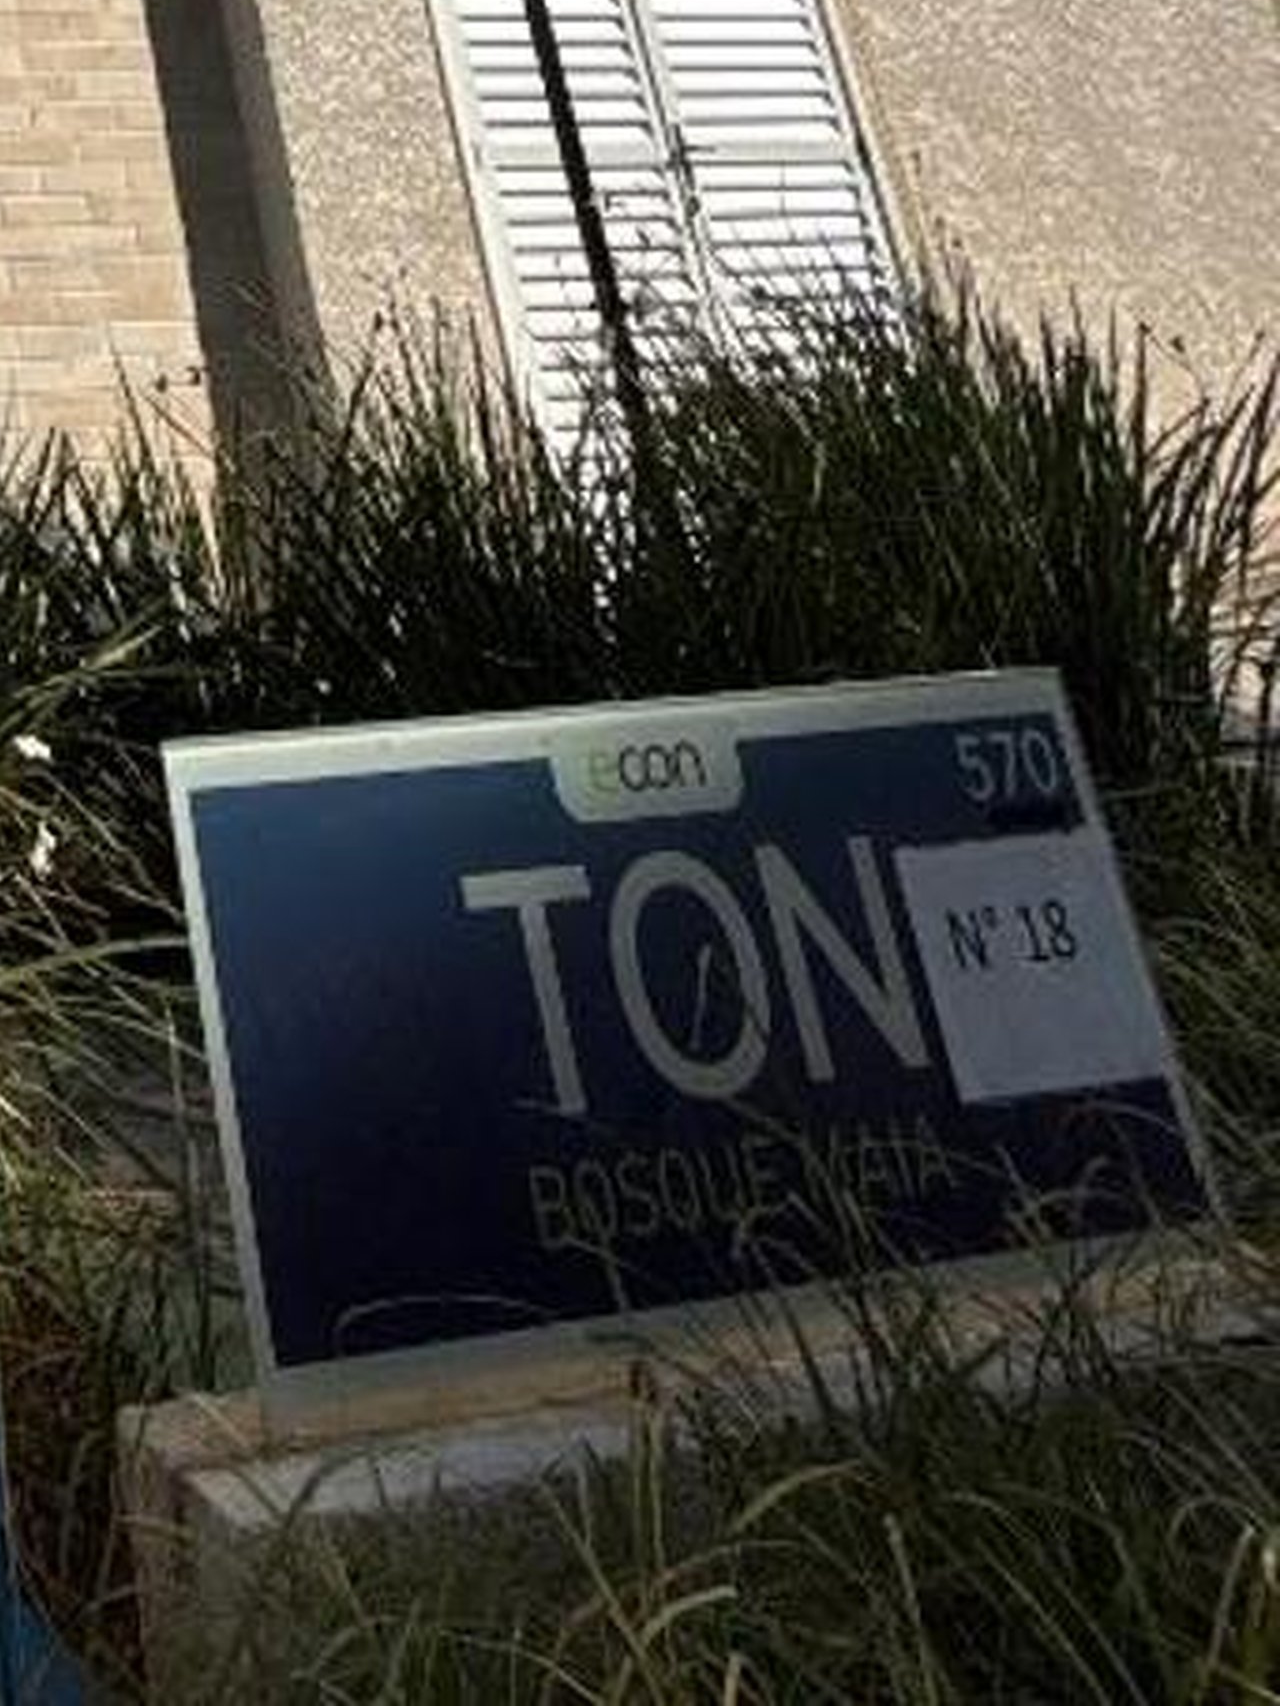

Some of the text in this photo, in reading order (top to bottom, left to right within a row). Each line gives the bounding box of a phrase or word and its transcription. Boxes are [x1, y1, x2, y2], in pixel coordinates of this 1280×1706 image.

[954, 726, 1058, 802] 570
[1010, 899, 1077, 962] 18
[459, 833, 931, 1117] TON
